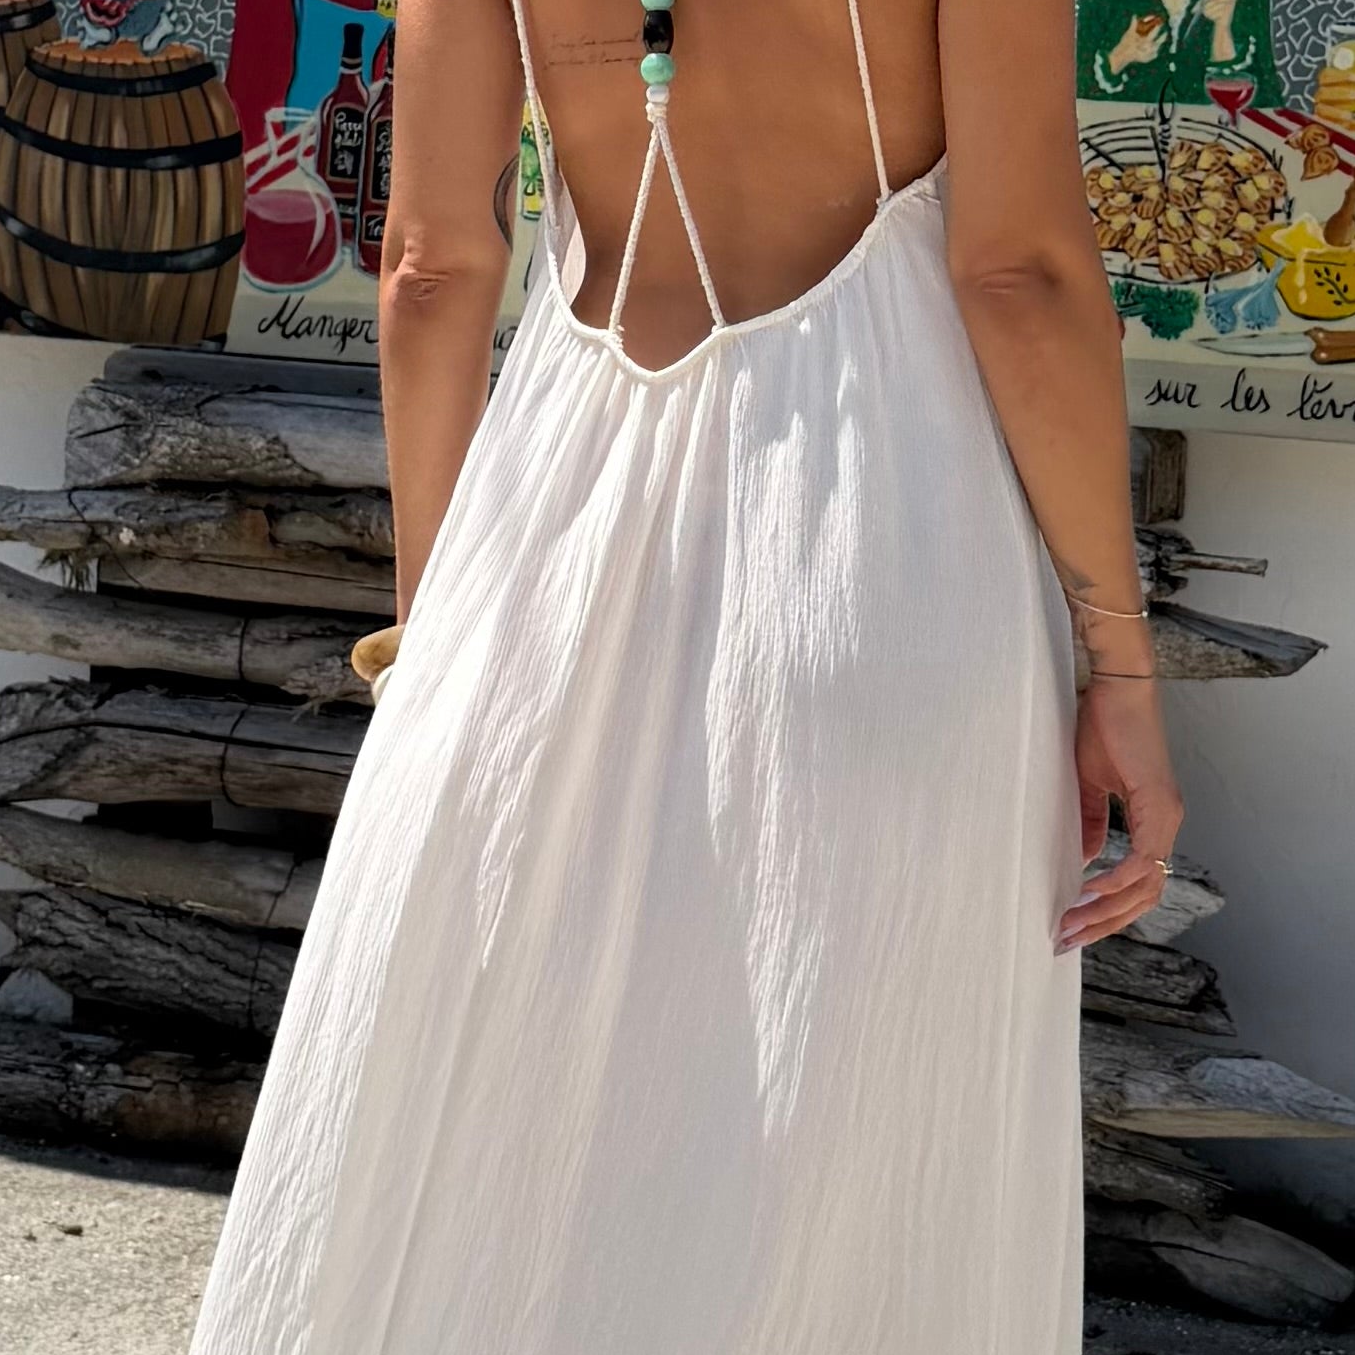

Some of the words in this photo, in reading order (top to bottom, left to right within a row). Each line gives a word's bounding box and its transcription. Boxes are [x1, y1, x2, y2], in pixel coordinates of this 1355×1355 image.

[256, 293, 379, 356] Manger
[1144, 378, 1202, 409] sur
[1220, 367, 1271, 414] les
